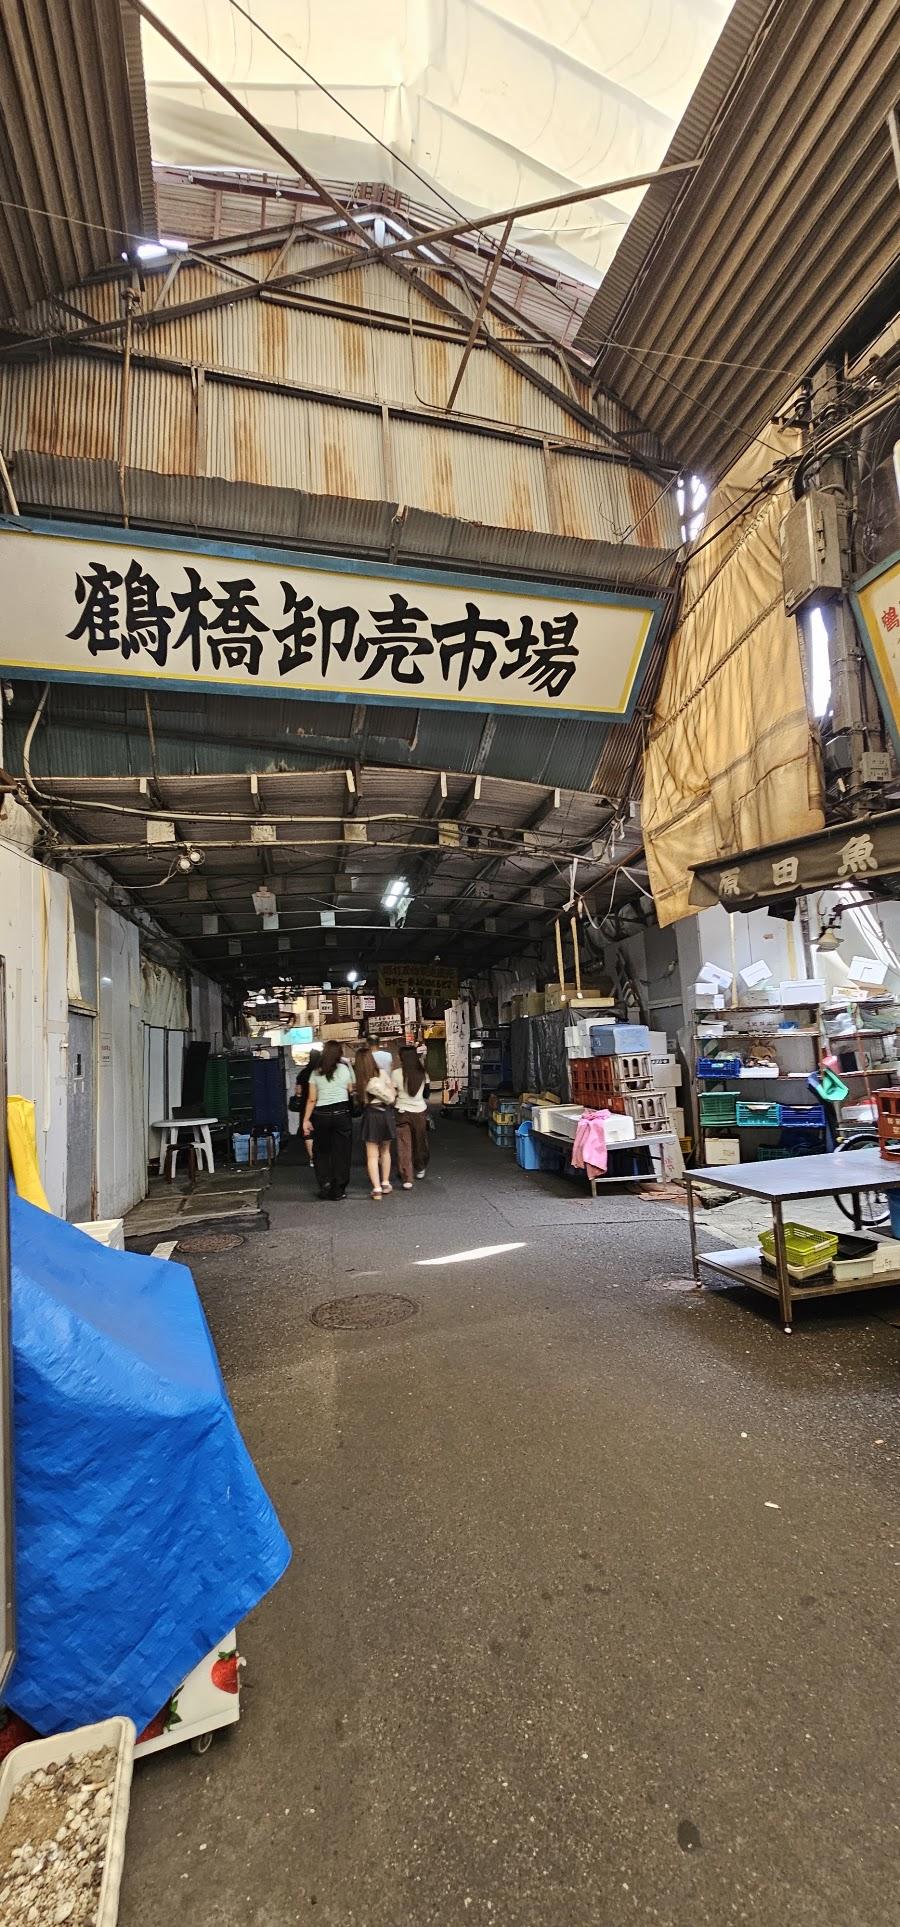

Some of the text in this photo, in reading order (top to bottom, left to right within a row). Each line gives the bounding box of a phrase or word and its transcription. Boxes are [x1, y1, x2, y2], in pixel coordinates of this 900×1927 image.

[66, 559, 579, 698] 鶴橋卸売市場
